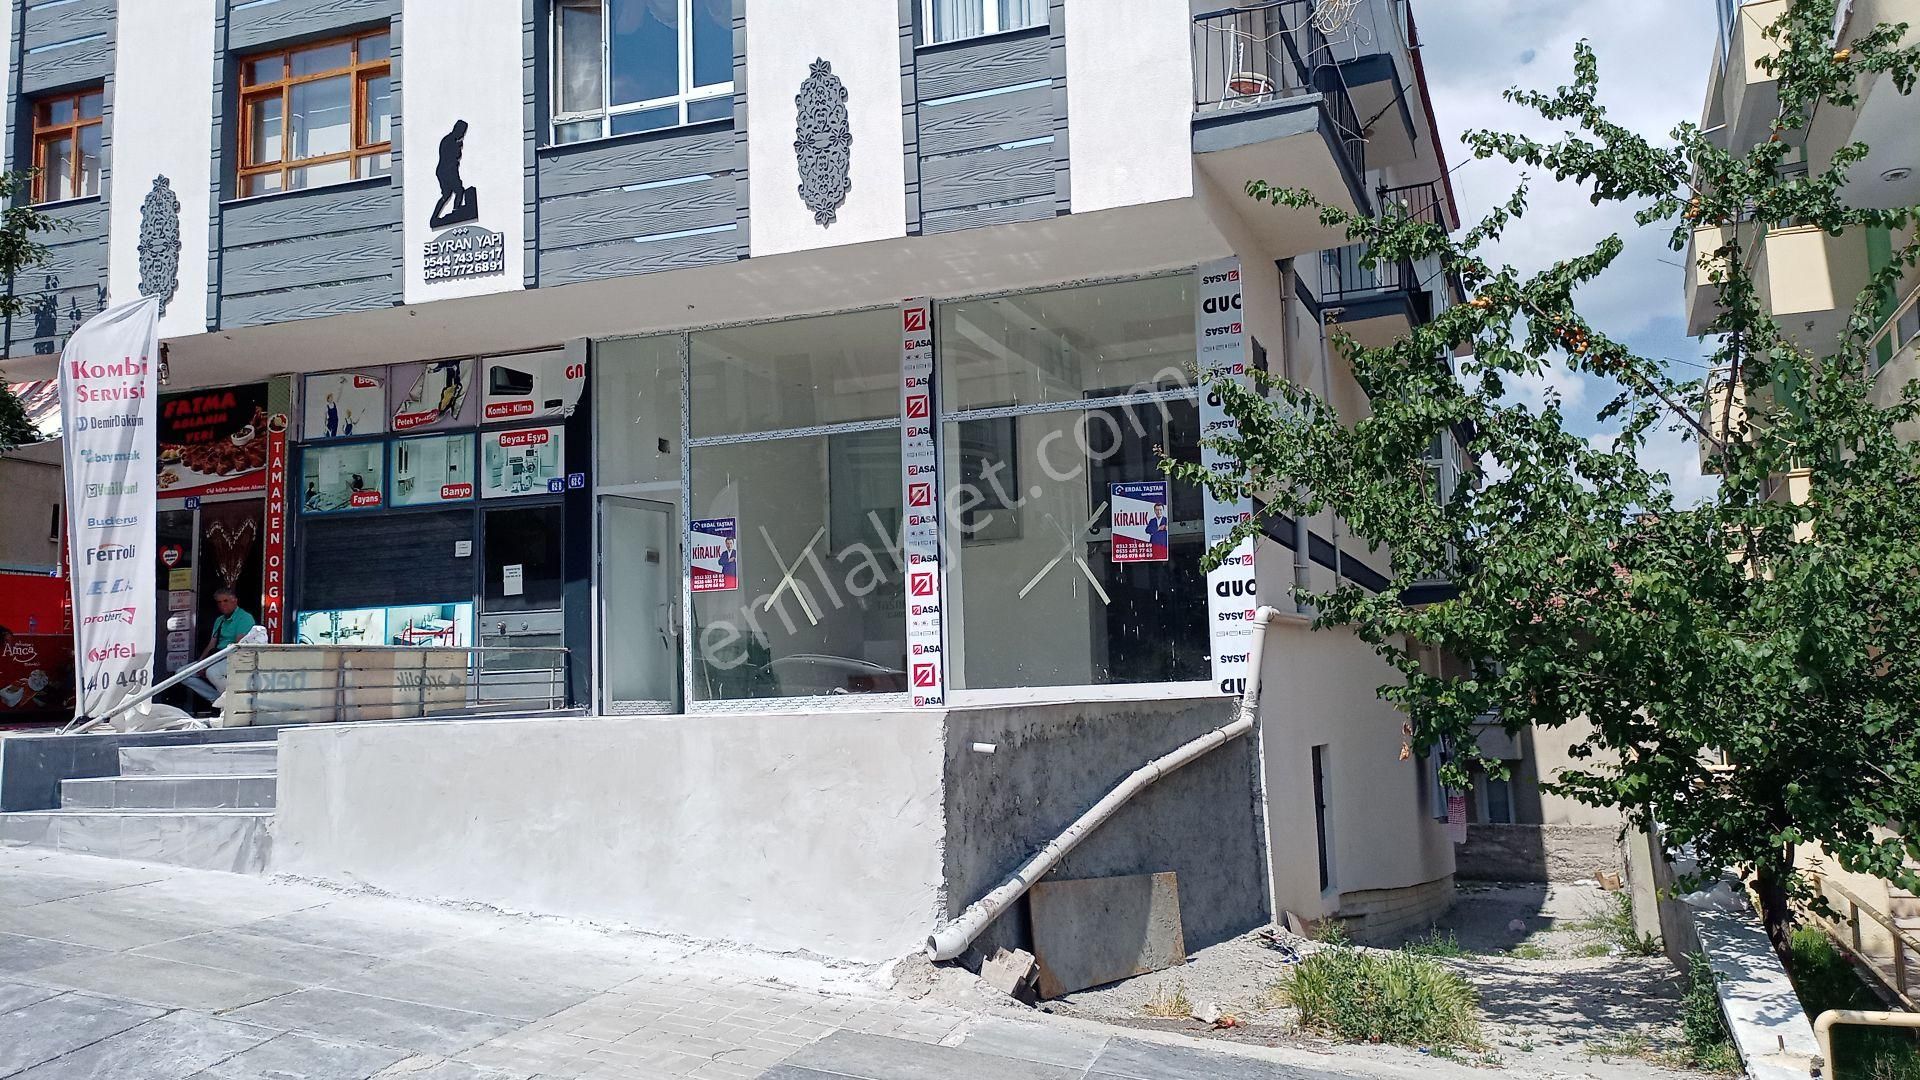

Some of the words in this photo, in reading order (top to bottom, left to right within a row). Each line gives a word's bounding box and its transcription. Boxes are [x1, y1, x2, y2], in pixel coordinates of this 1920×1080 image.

[424, 237, 472, 255] SEYRAN
[475, 233, 502, 249] YAPI
[424, 255, 451, 268] 0544
[424, 267, 451, 279] 0545
[71, 356, 148, 380] Kombi
[164, 392, 237, 419] FATMA
[488, 405, 508, 416] Kombi
[513, 404, 532, 414] Klima
[91, 414, 144, 430] DemirDöküm
[500, 434, 525, 446] Beyaz
[528, 433, 547, 445] Eşya
[95, 450, 140, 464] baymak
[269, 442, 282, 544] TAMAMEN
[443, 487, 470, 497] Banyo
[353, 495, 378, 505] Fayans
[87, 515, 138, 527] Buderus
[1114, 509, 1149, 526] KİRALIK
[87, 544, 136, 566] Ferroli
[692, 544, 721, 559] KİRALIK
[2, 642, 34, 656] Amca
